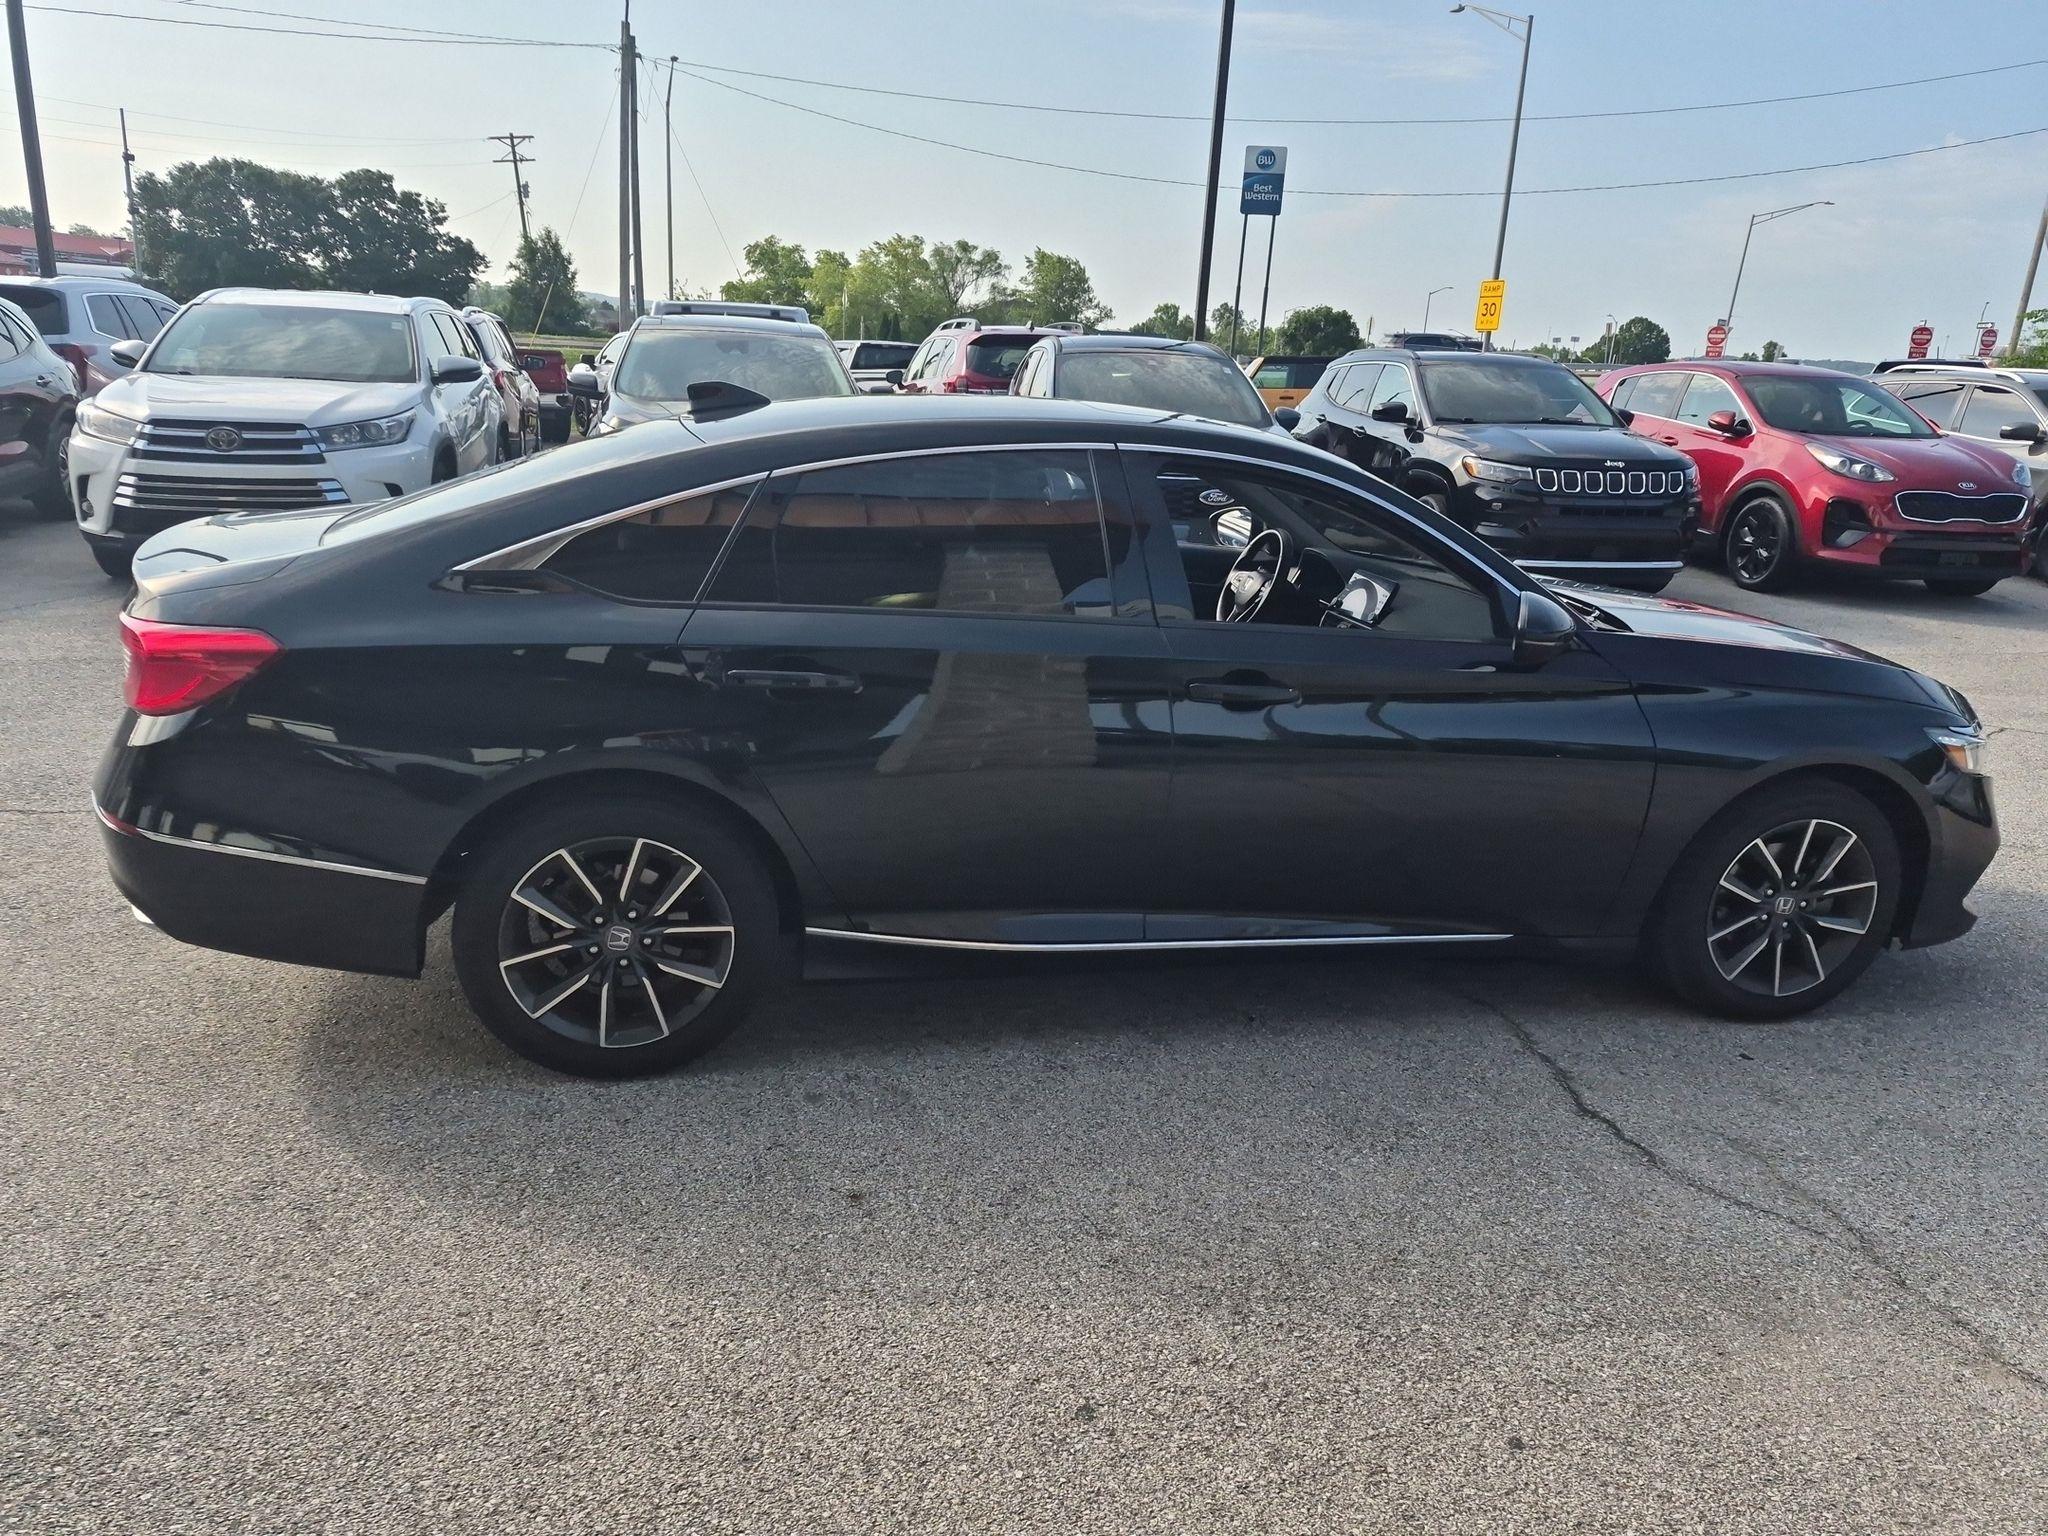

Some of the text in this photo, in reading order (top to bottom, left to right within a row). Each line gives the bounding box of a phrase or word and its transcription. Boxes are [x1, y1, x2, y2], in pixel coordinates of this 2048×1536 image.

[1257, 155, 1274, 165] BW
[1253, 183, 1273, 192] Best
[1244, 191, 1280, 201] Western
[1483, 284, 1501, 292] RAMP
[1481, 302, 1497, 317] 30
[1604, 459, 1626, 468] Jeep
[1207, 492, 1228, 502] Ford
